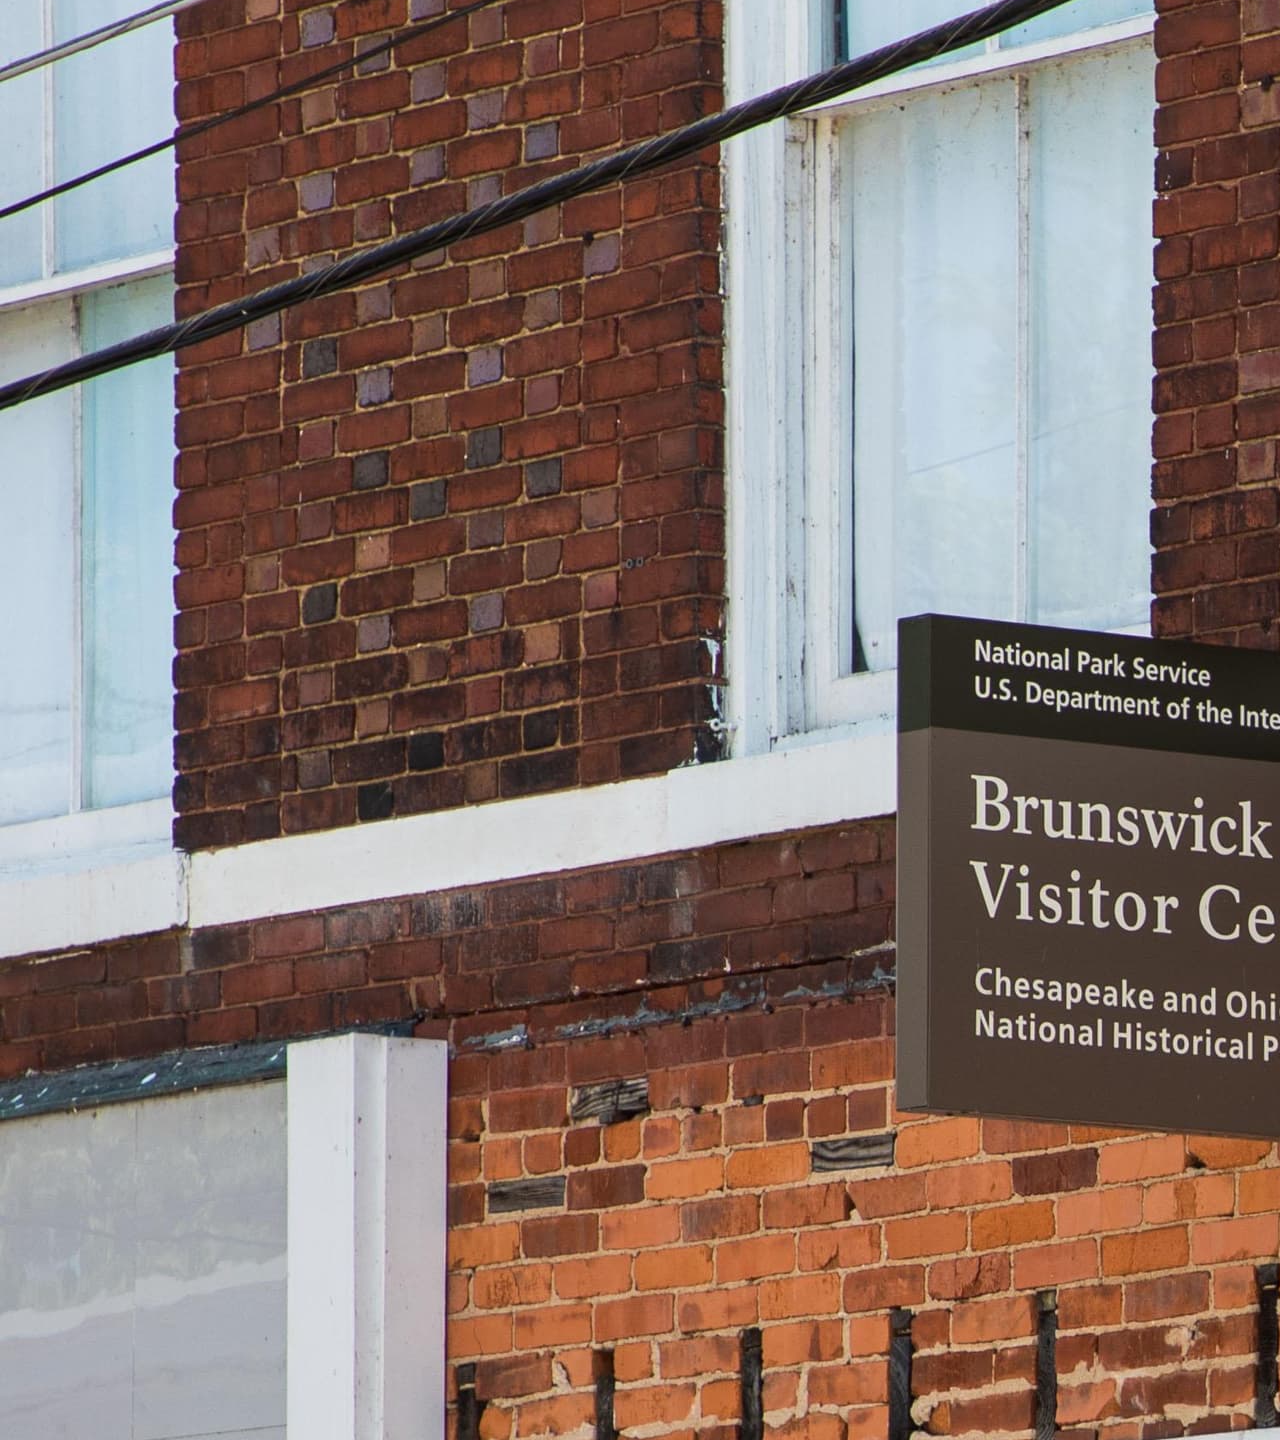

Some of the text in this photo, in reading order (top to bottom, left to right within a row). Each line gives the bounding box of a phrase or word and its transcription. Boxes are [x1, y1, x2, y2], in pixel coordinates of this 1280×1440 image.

[974, 639, 1211, 687] National Park Service
[974, 675, 1018, 702] U.S.
[1025, 681, 1160, 718] Department
[1166, 696, 1190, 721] of
[1196, 699, 1233, 725] the
[970, 773, 1273, 859] Brunswick
[969, 859, 1179, 935] Visitor
[974, 967, 1154, 1010] Chesapeake
[1163, 988, 1217, 1016] and
[974, 1008, 1103, 1047] National
[1112, 1021, 1254, 1060] Historical
